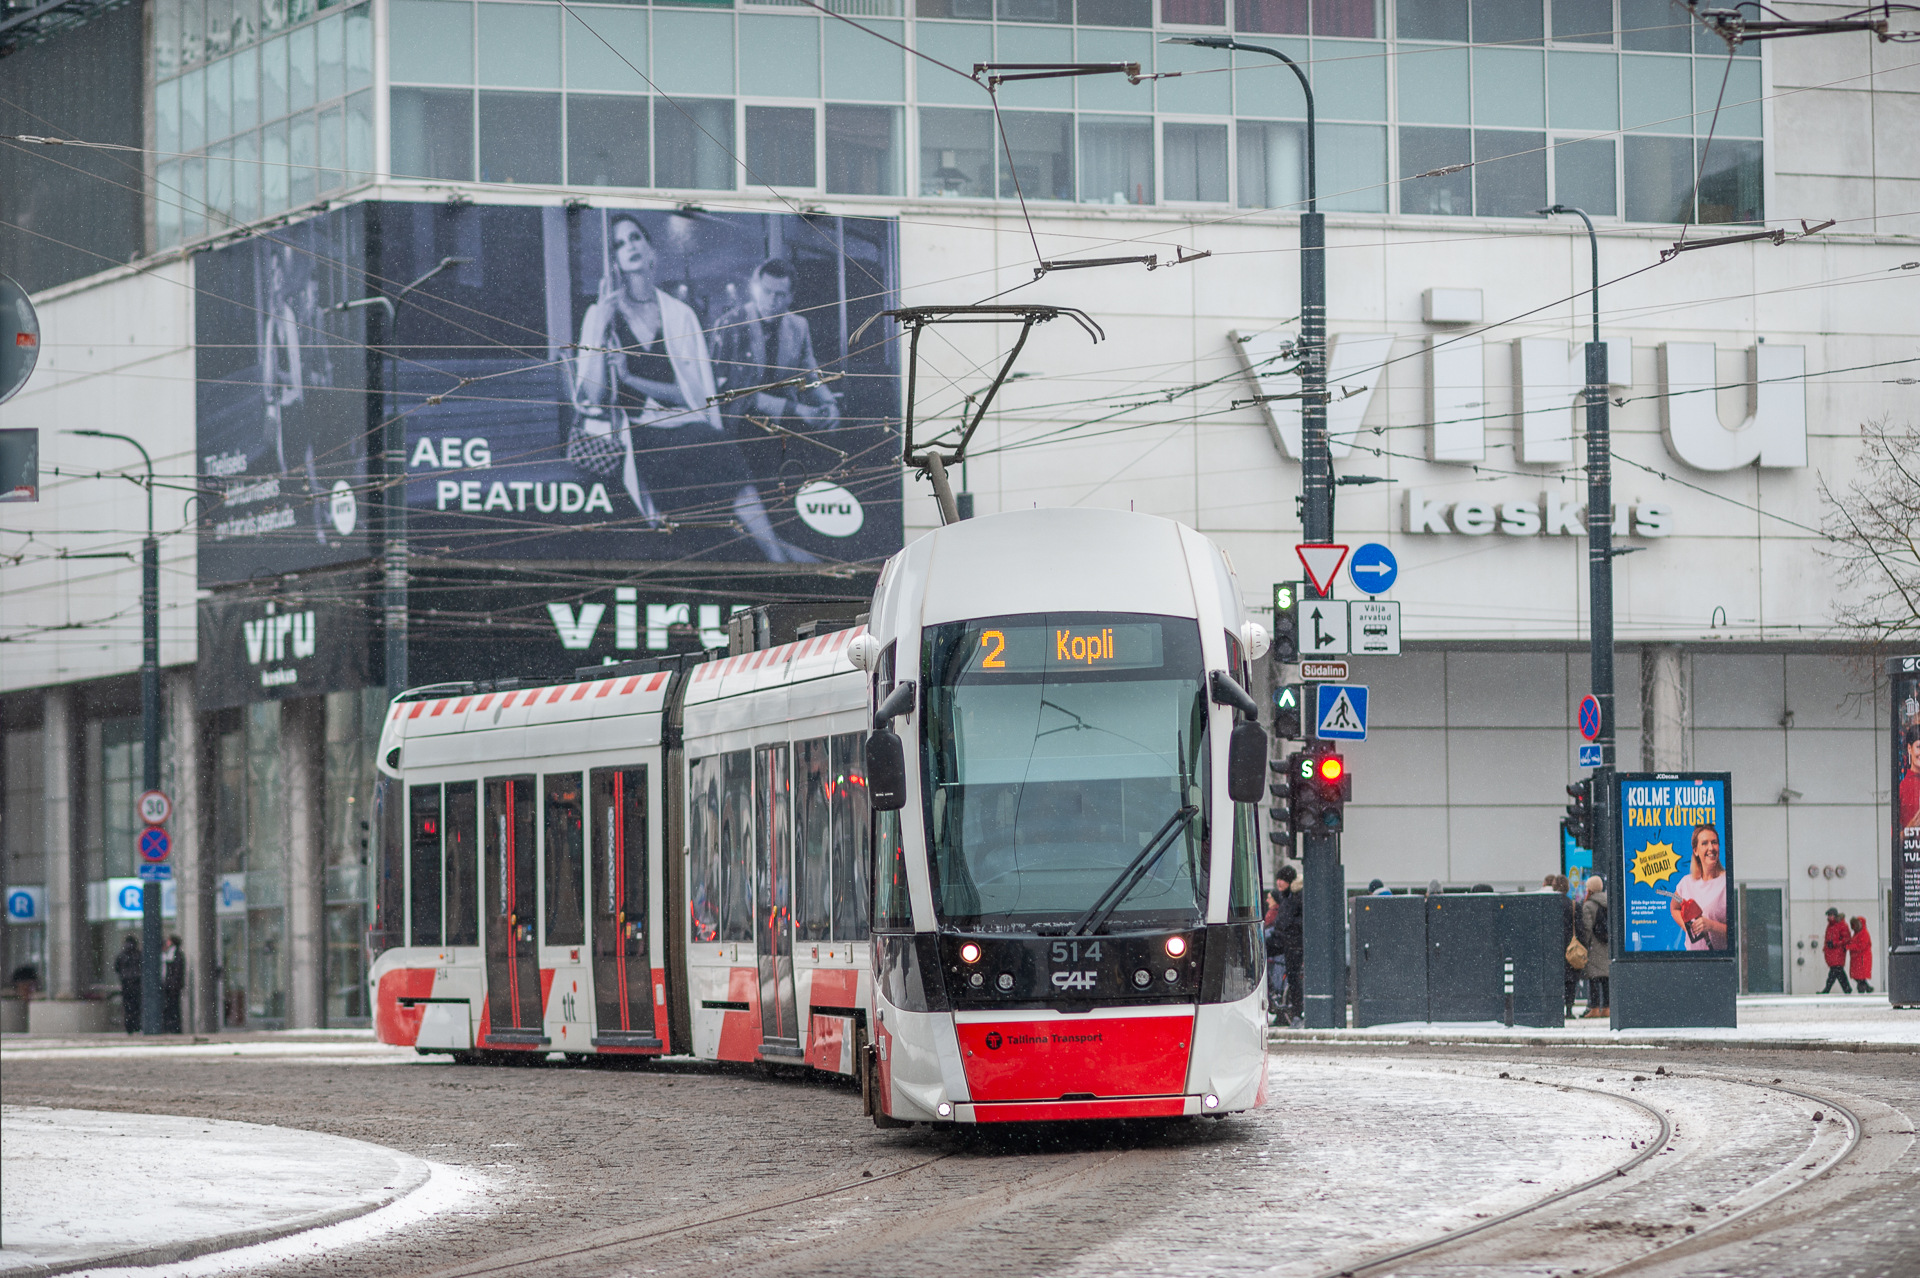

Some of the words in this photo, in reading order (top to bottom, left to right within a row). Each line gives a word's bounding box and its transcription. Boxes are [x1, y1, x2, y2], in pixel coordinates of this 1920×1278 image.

[1229, 287, 1808, 471] viru
[410, 437, 492, 468] AEG
[436, 480, 614, 513] PEATUDA
[806, 503, 851, 515] viru
[546, 587, 752, 650] viru
[1365, 605, 1386, 613] Välja
[243, 602, 315, 665] viru
[982, 630, 1006, 668] 2
[1057, 628, 1114, 664] Kopli
[1304, 665, 1345, 677] Südalinn
[1628, 787, 1671, 806] KOLME
[1675, 787, 1715, 806] KUUGA
[147, 800, 164, 815] 30
[1629, 808, 1661, 827] PAAK
[1665, 805, 1716, 827] KÜTUST!
[1052, 941, 1102, 962] 514
[1051, 970, 1098, 990] CAF
[1006, 1034, 1049, 1045] Tallinna
[1050, 1032, 1103, 1043] Transport
